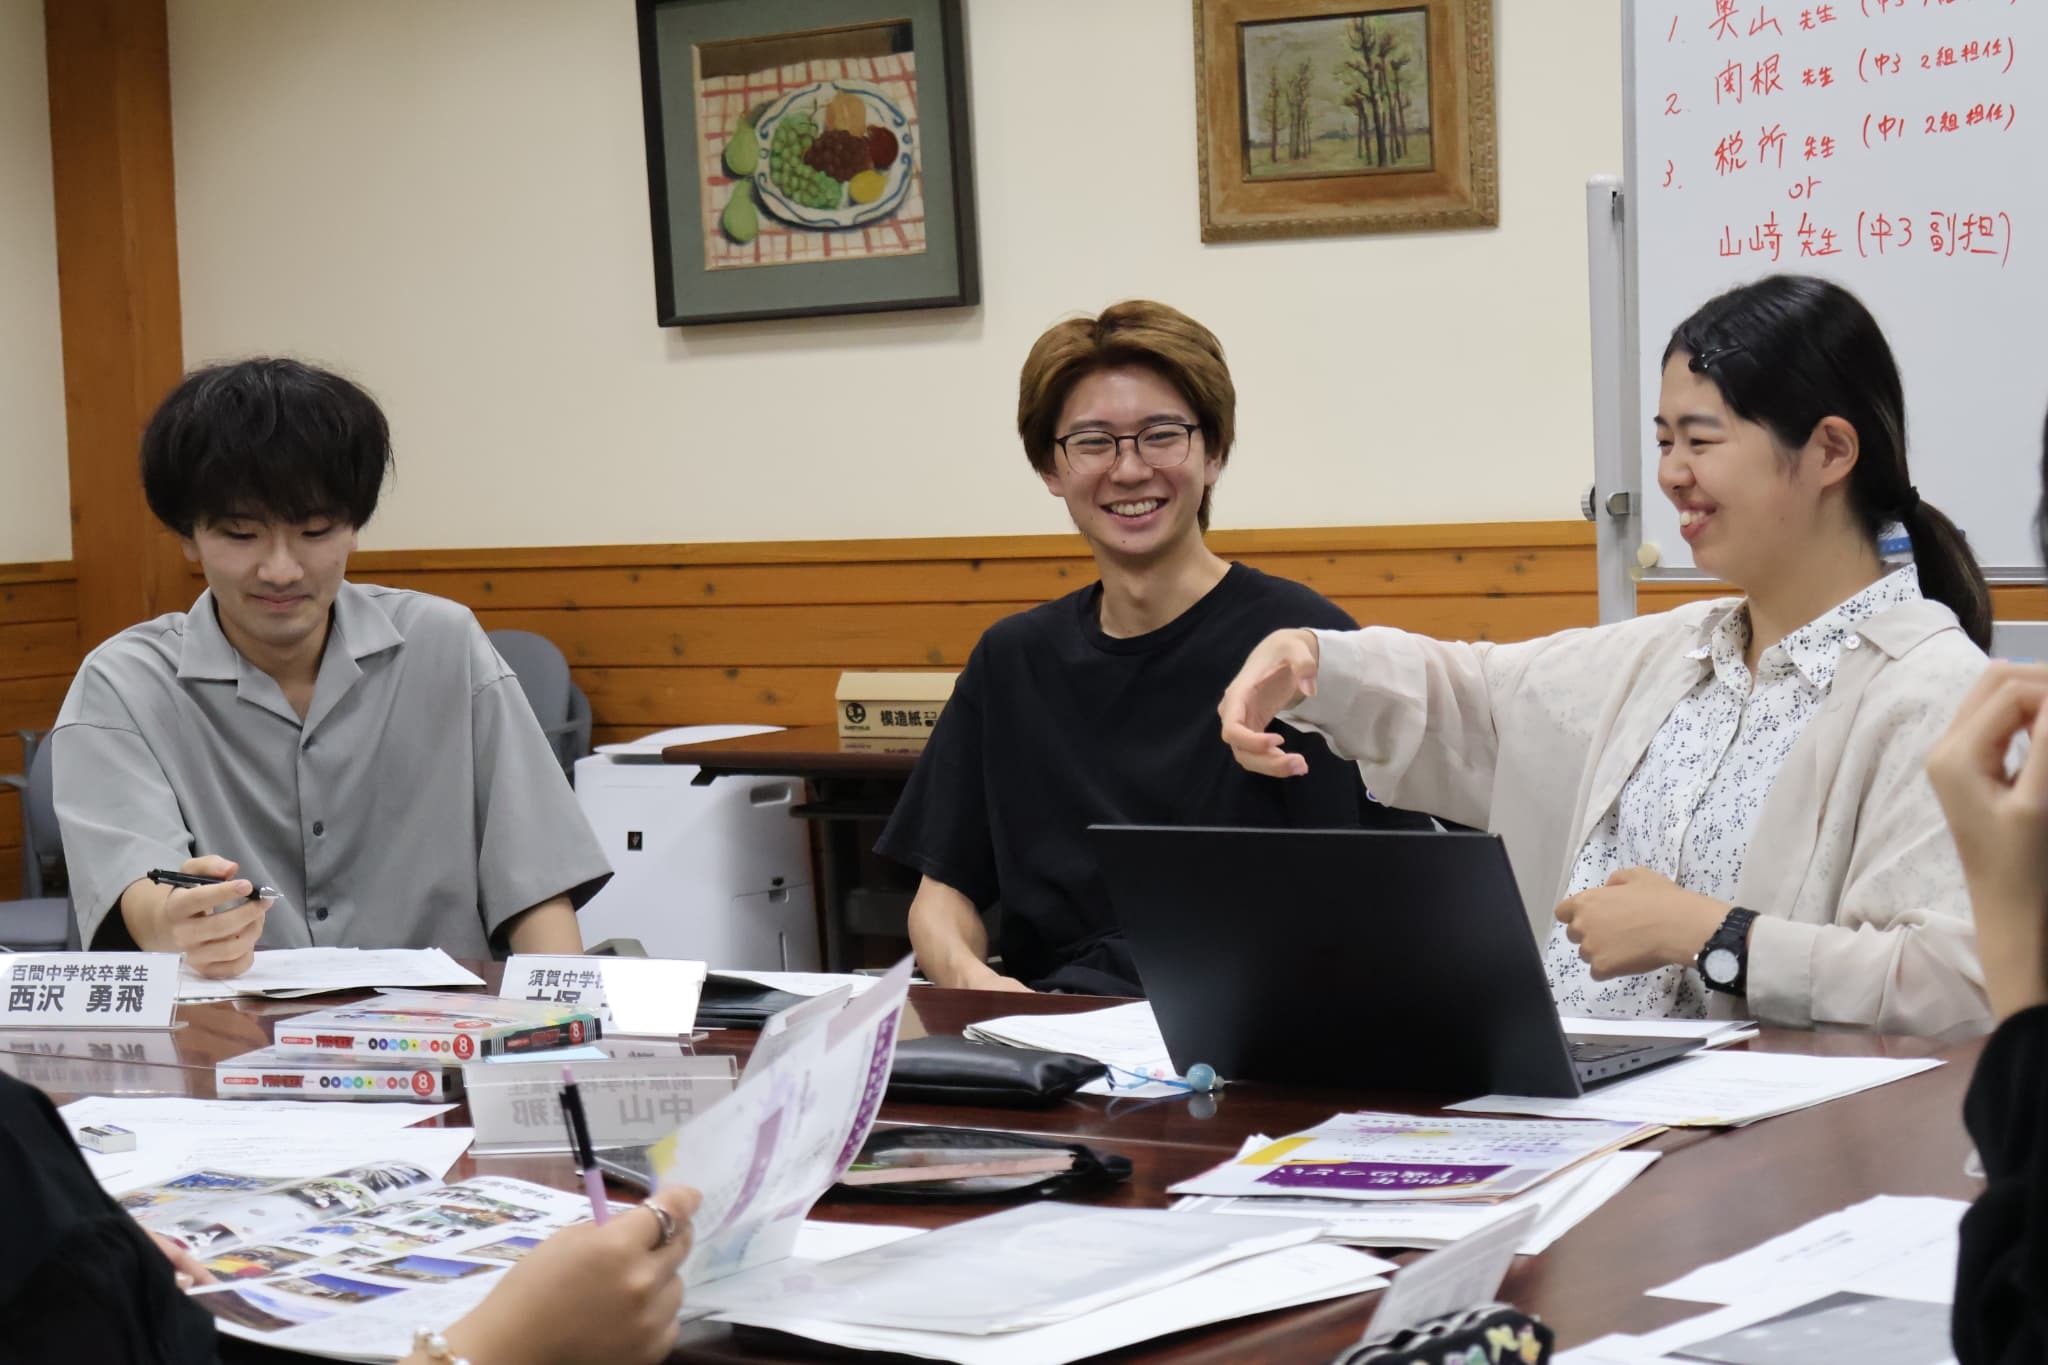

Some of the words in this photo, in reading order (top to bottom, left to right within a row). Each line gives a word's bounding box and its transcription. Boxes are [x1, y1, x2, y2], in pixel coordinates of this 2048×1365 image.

[1800, 5, 1837, 32] 先生
[1802, 66, 1835, 88] 先生
[1803, 135, 1836, 159] 先生
[1788, 175, 1822, 200] or
[880, 710, 923, 727] 模造紙
[8, 984, 66, 1012] 西沢
[85, 984, 145, 1012] 勇飛
